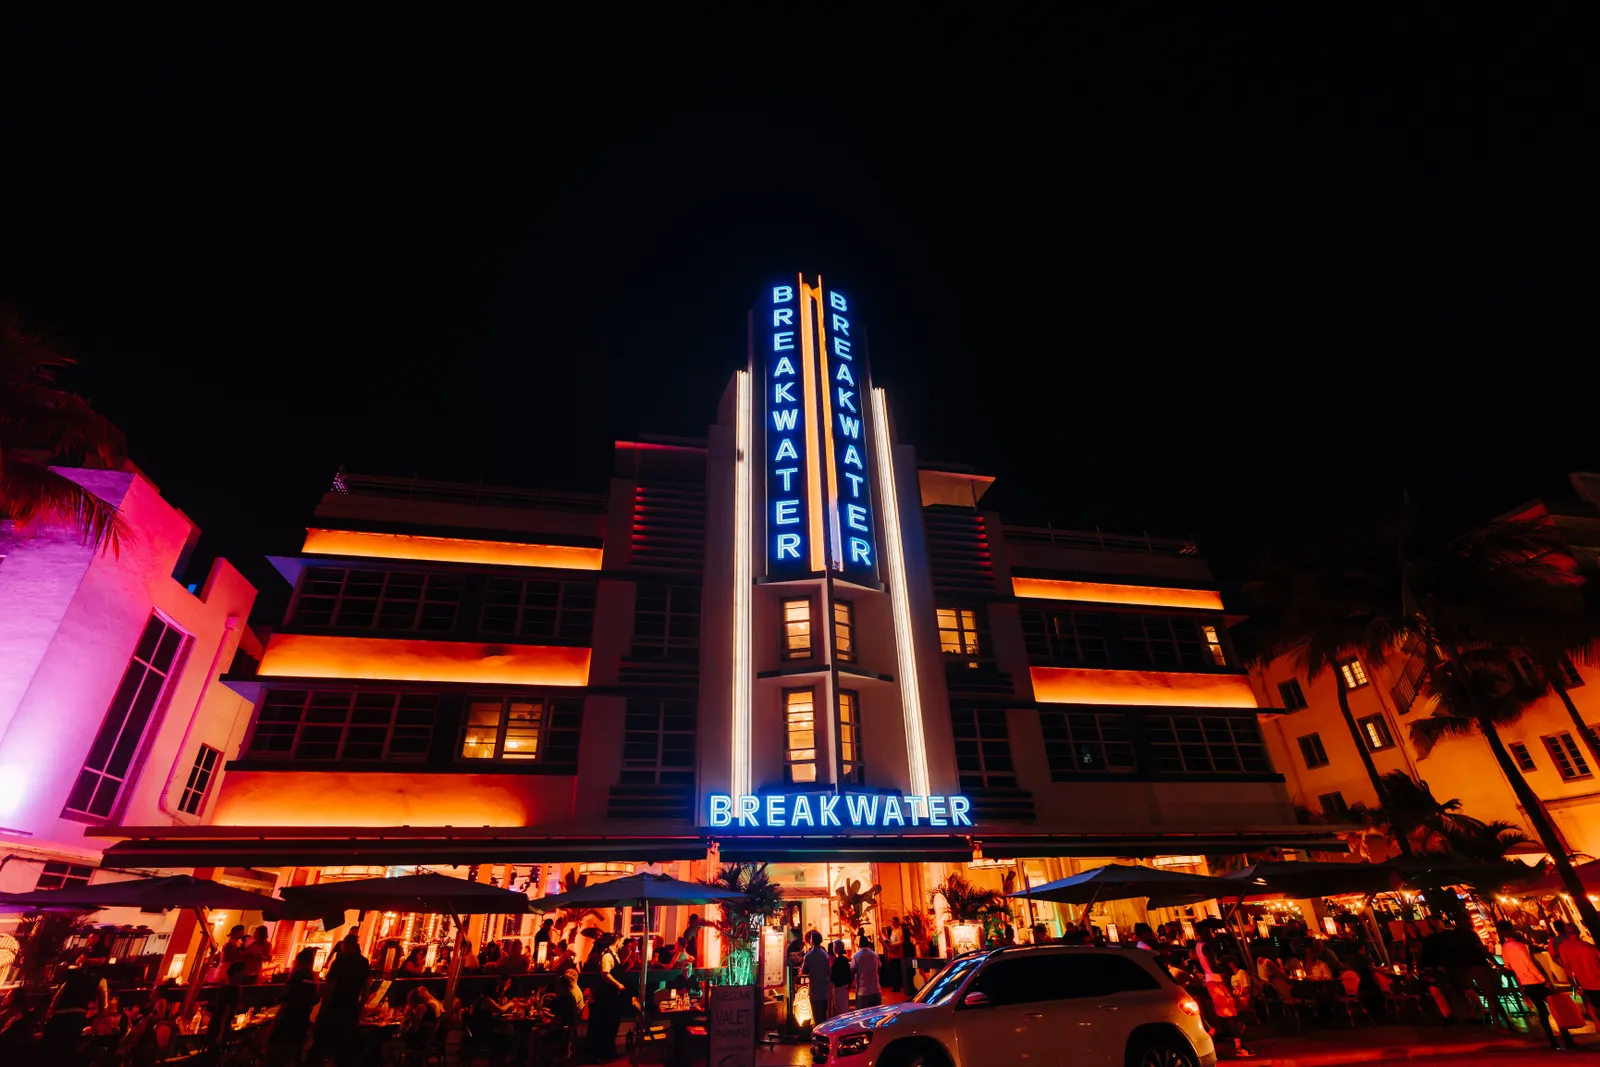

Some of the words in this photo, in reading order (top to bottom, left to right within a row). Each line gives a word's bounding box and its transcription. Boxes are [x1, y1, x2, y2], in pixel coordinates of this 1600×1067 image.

[772, 285, 801, 560] BREAKWATER
[829, 290, 872, 566] BREAKWATER
[709, 795, 972, 827] BREAKWATER
[716, 1009, 751, 1025] VALET
